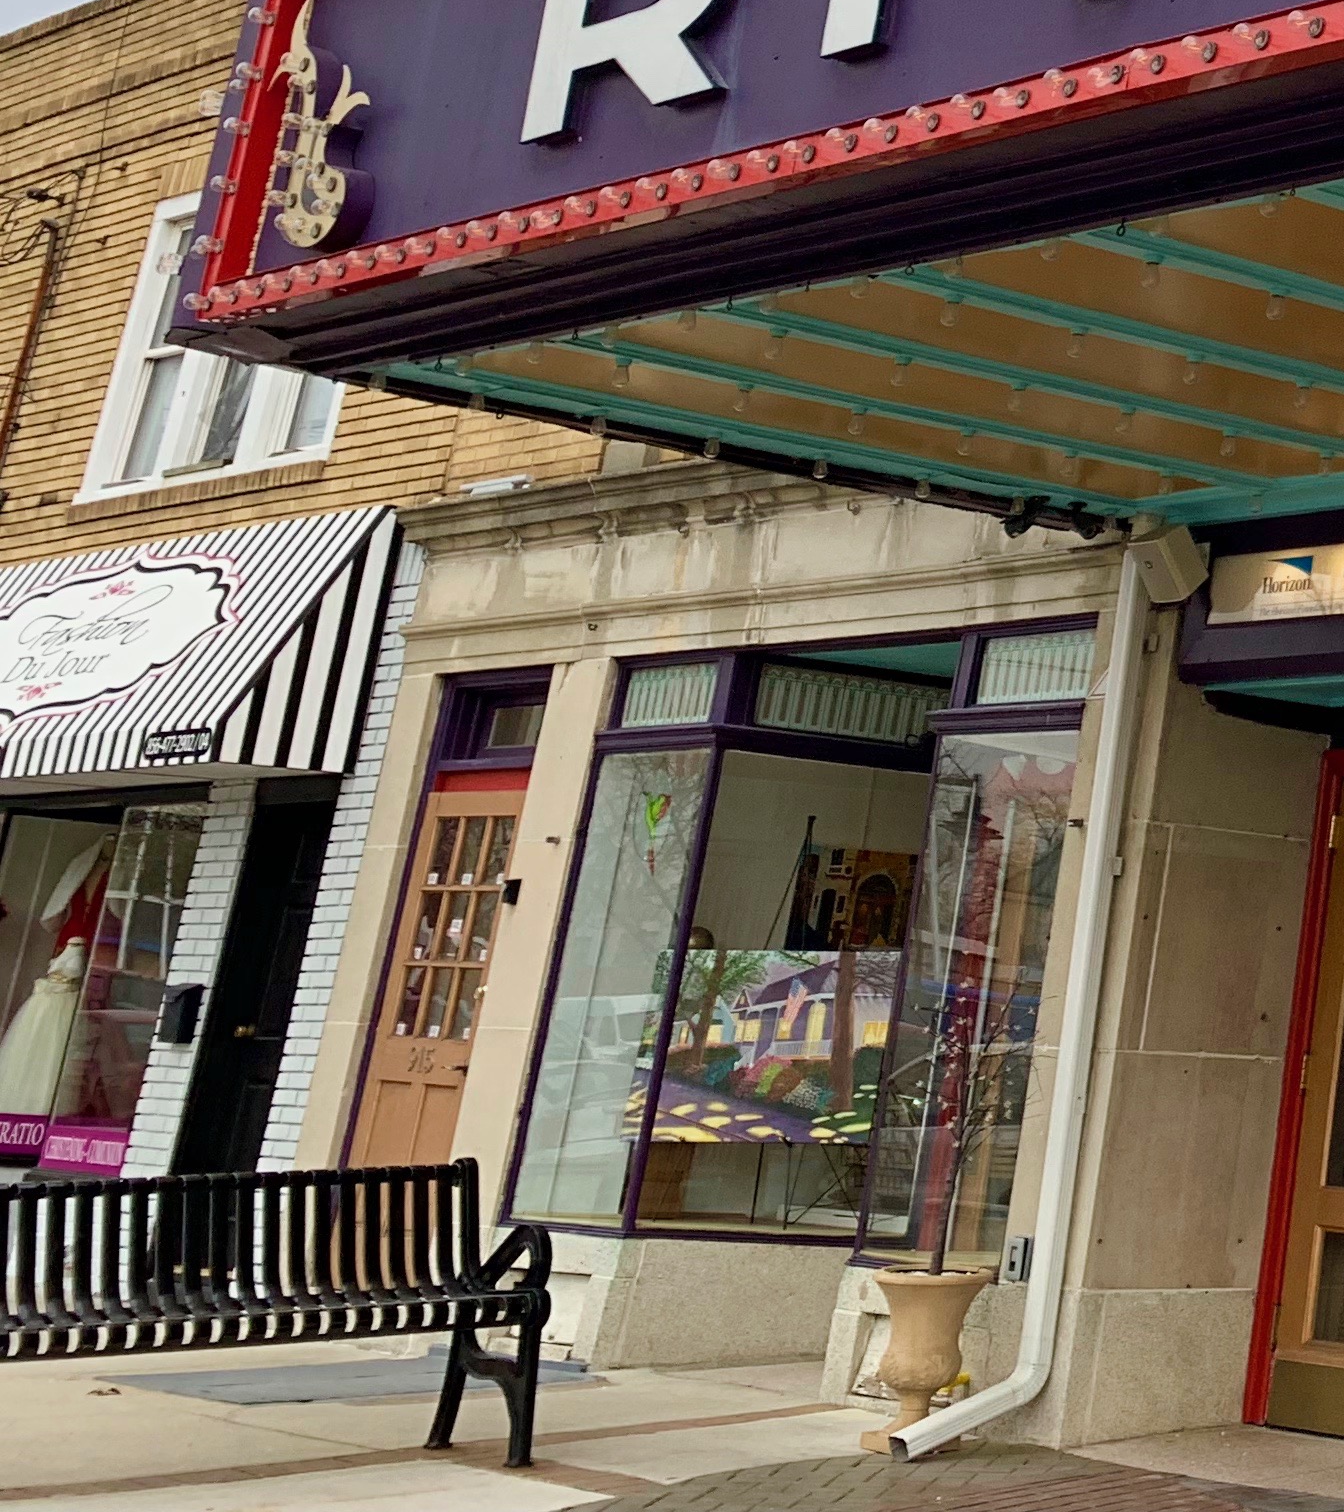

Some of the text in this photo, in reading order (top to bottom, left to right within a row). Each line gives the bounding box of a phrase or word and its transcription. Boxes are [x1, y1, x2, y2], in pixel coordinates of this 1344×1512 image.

[1263, 576, 1311, 594] Horizon
[1, 651, 110, 683] Du Jour
